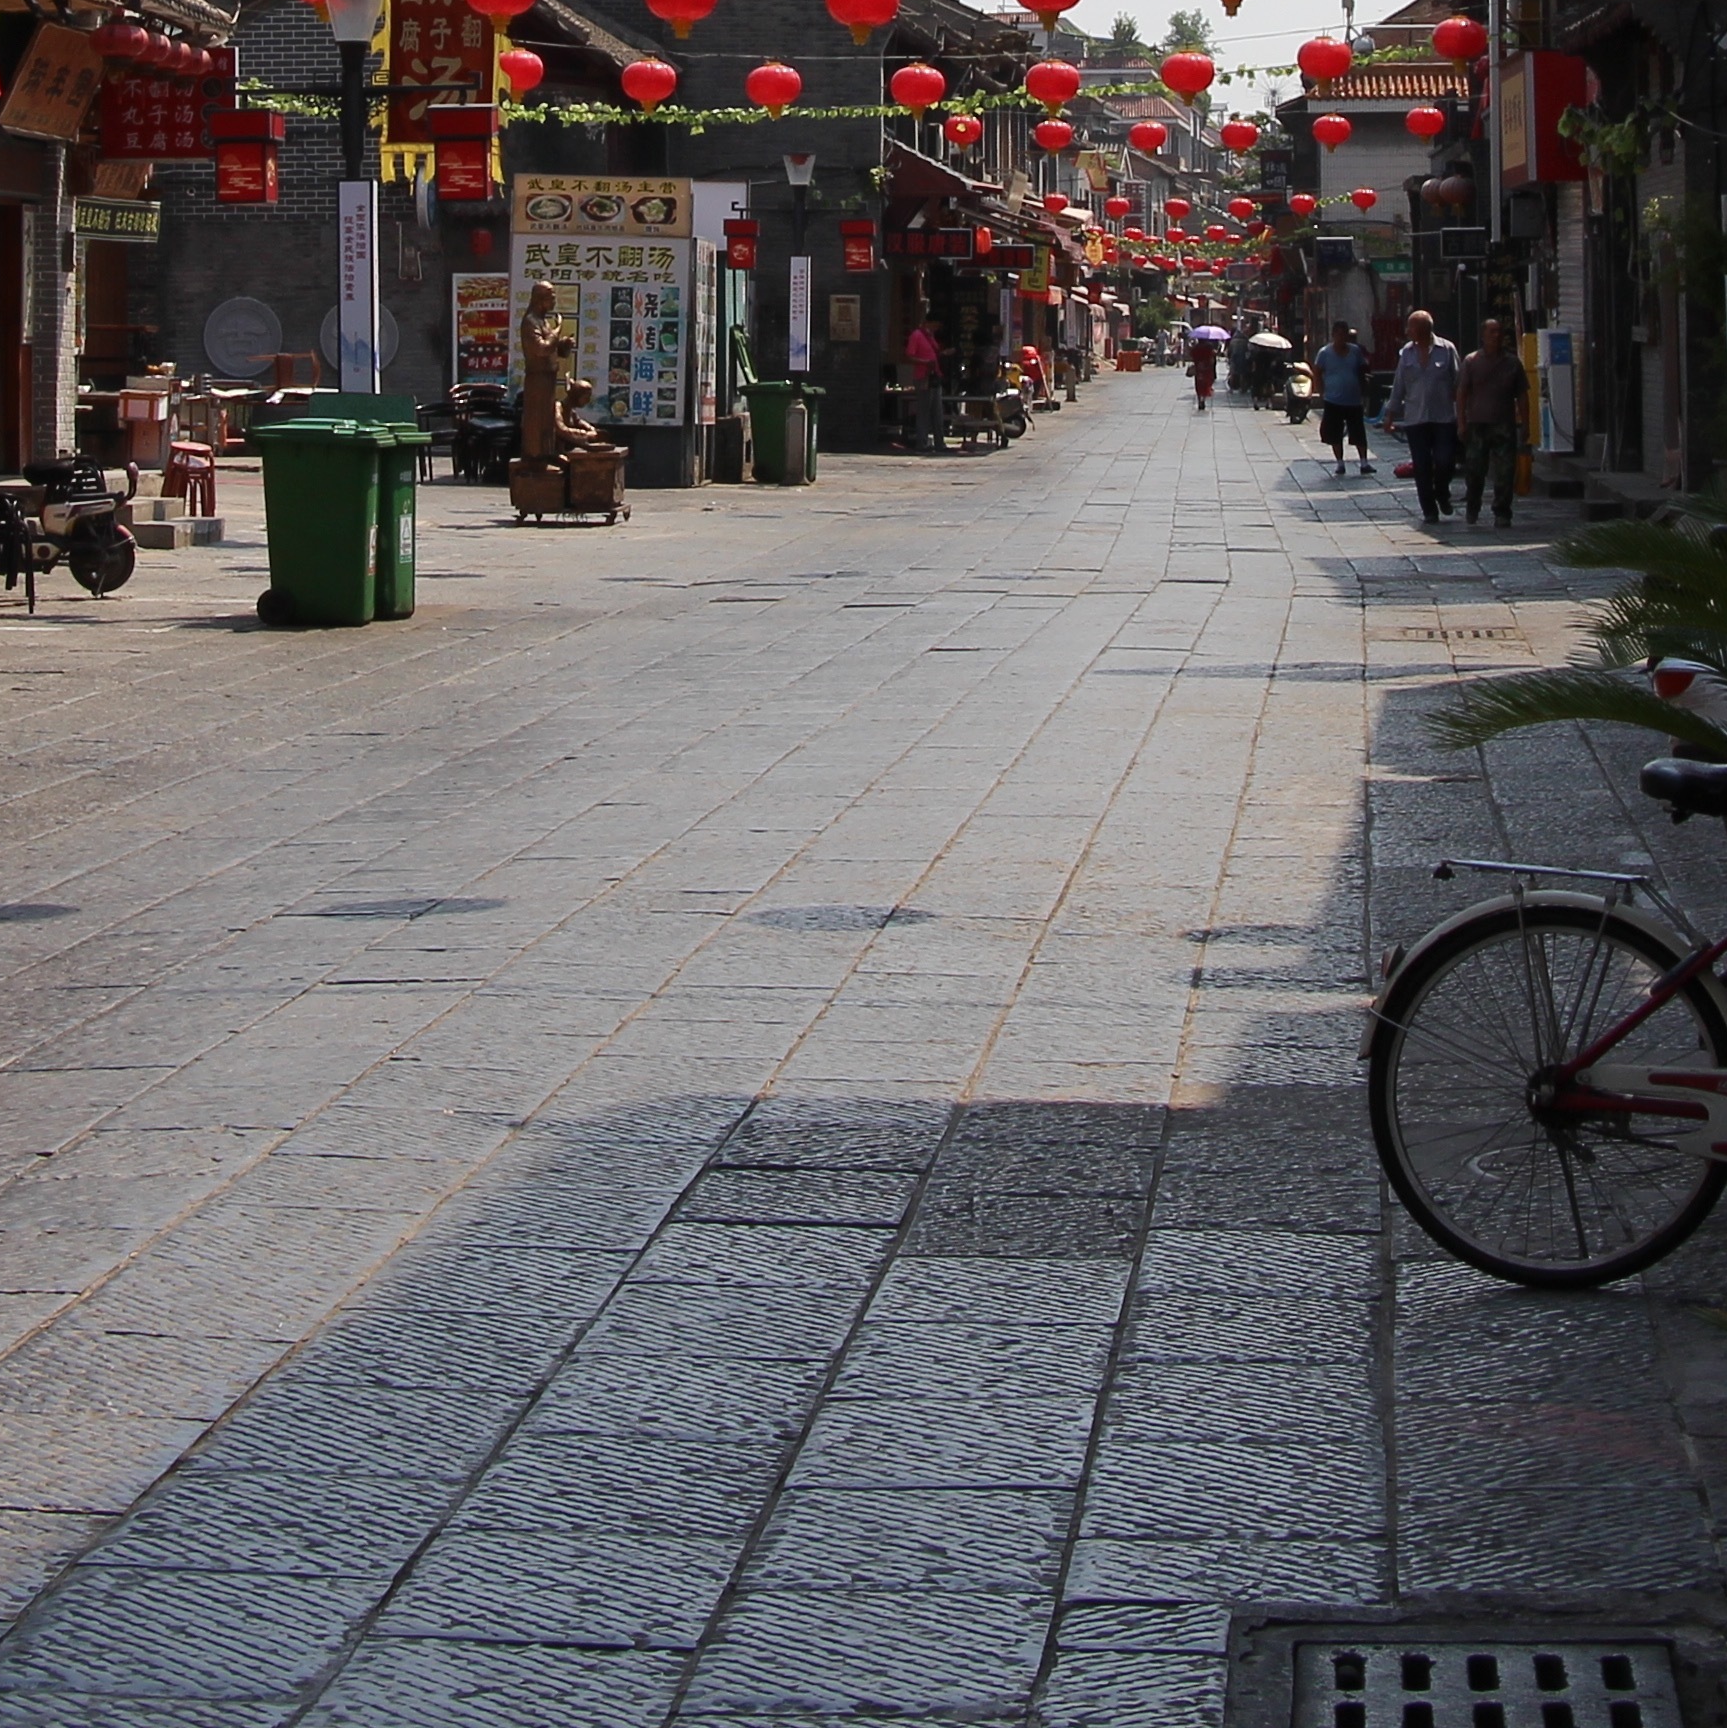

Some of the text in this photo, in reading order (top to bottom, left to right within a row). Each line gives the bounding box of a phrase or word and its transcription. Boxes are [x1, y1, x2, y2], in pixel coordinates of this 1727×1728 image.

[122, 105, 194, 125] 丸子汤
[122, 131, 194, 151] 豆腐汤
[527, 178, 677, 194] 武皇不翻汤主营
[524, 242, 676, 270] 武皇不翻汤
